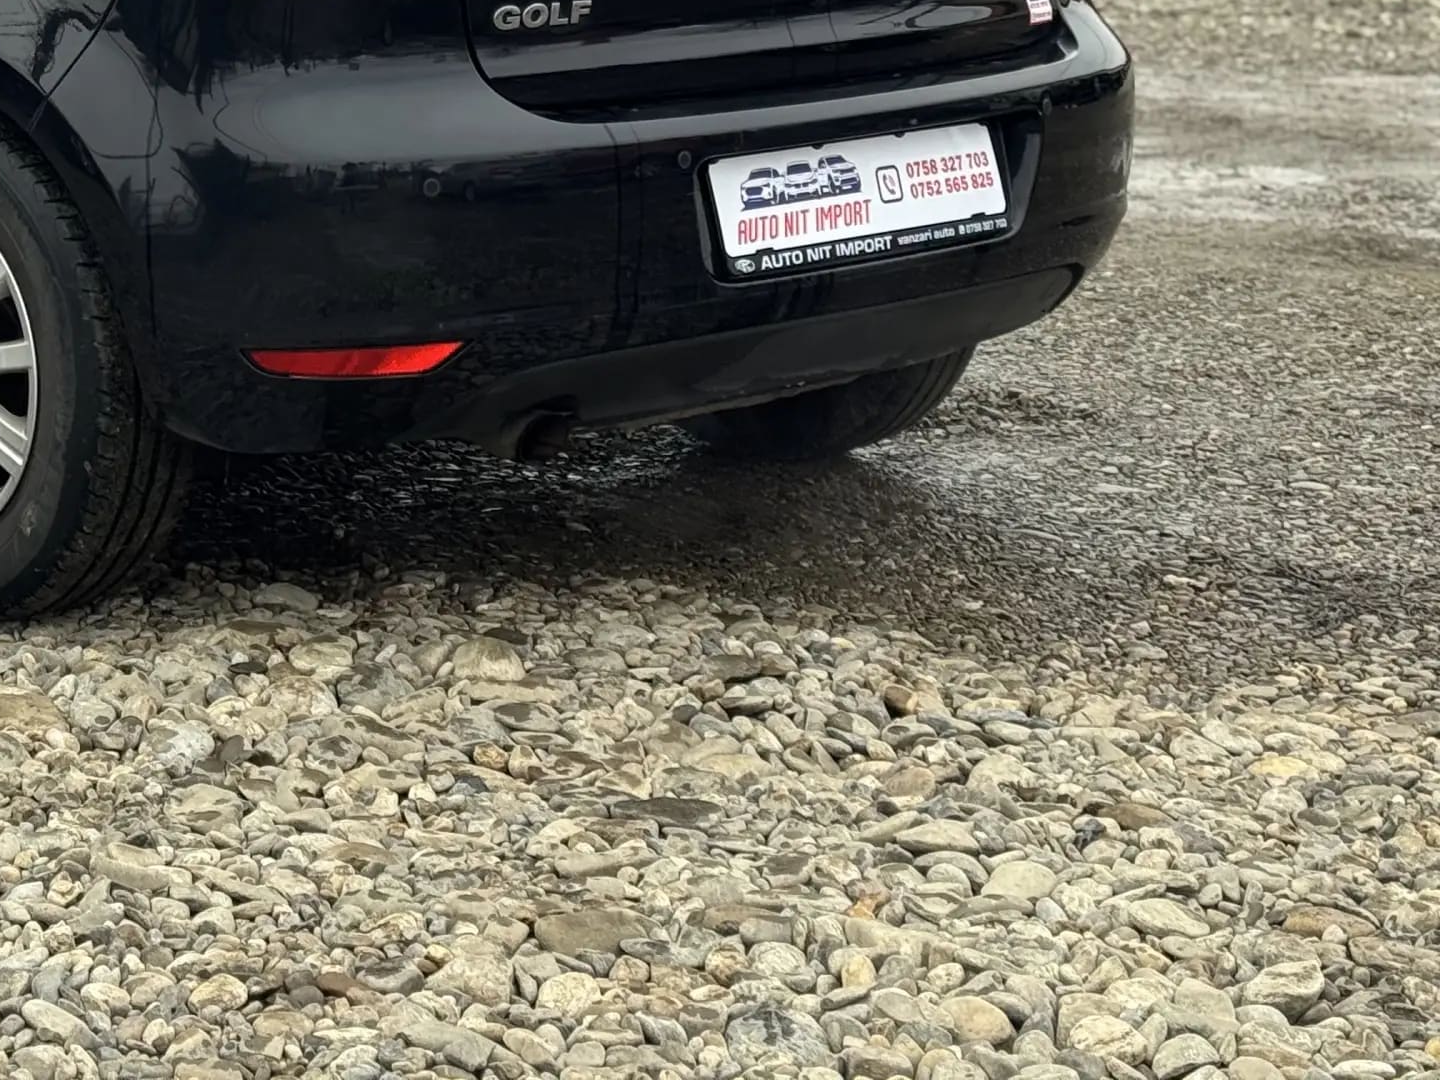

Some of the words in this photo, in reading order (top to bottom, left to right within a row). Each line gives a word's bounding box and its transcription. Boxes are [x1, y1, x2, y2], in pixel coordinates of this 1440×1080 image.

[493, 0, 592, 31] GOLF
[906, 159, 938, 179] 0758
[940, 155, 964, 173] 327
[966, 151, 989, 169] 703
[910, 180, 943, 199] 0752
[946, 176, 969, 194] 565
[971, 172, 994, 190] 825
[738, 215, 780, 245] AUTO
[784, 208, 809, 237] NIT
[815, 199, 872, 232] IMPORT
[760, 249, 804, 270] AUTO
[807, 245, 832, 263] NIT
[836, 235, 892, 258] IMPORT
[934, 226, 956, 239] auto
